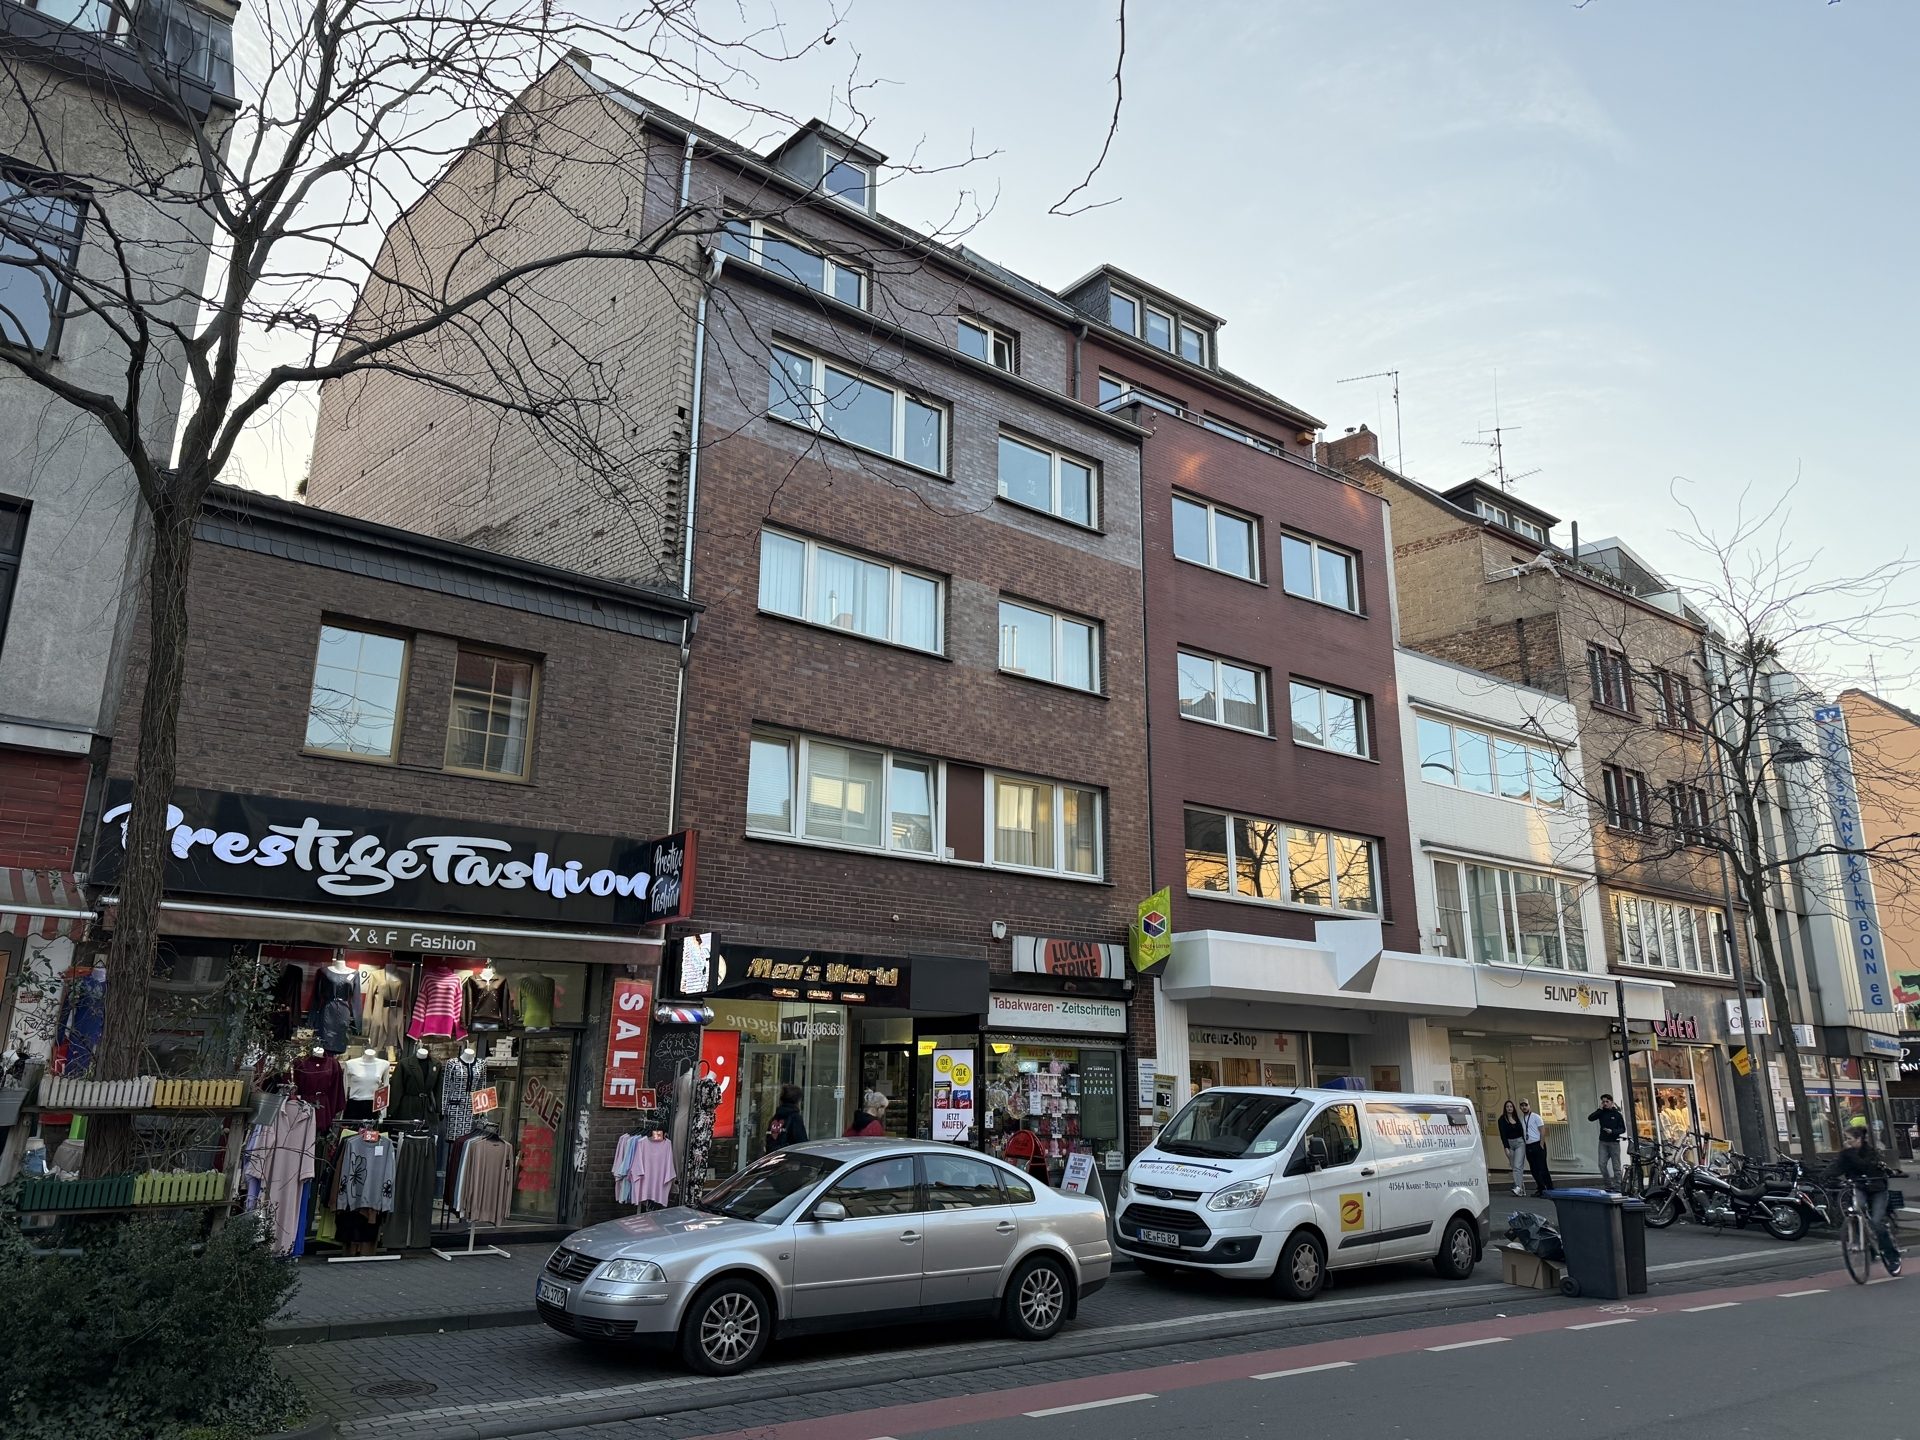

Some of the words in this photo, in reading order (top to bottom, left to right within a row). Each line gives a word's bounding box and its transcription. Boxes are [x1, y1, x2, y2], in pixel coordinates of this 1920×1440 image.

[653, 841, 684, 890] Prestige
[649, 877, 680, 915] Fashion
[347, 927, 361, 943] X
[366, 928, 379, 944] &
[385, 931, 398, 945] F
[410, 932, 476, 951] Fashion
[1858, 920, 1878, 974] BONN
[1051, 942, 1094, 962] LUCKY
[746, 956, 821, 982] Men's
[1051, 959, 1098, 977] STRIKE
[993, 996, 1054, 1013] Tabakwaren
[1061, 1001, 1121, 1017] Zeitschriften
[610, 992, 644, 1096] SALE
[523, 1076, 564, 1132] SALE
[941, 1120, 964, 1129] KAUFEN
[946, 1112, 960, 1121] JETZT
[1143, 1229, 1154, 1240] NE
[1156, 1231, 1166, 1242] FG
[1167, 1233, 1177, 1244] 82
